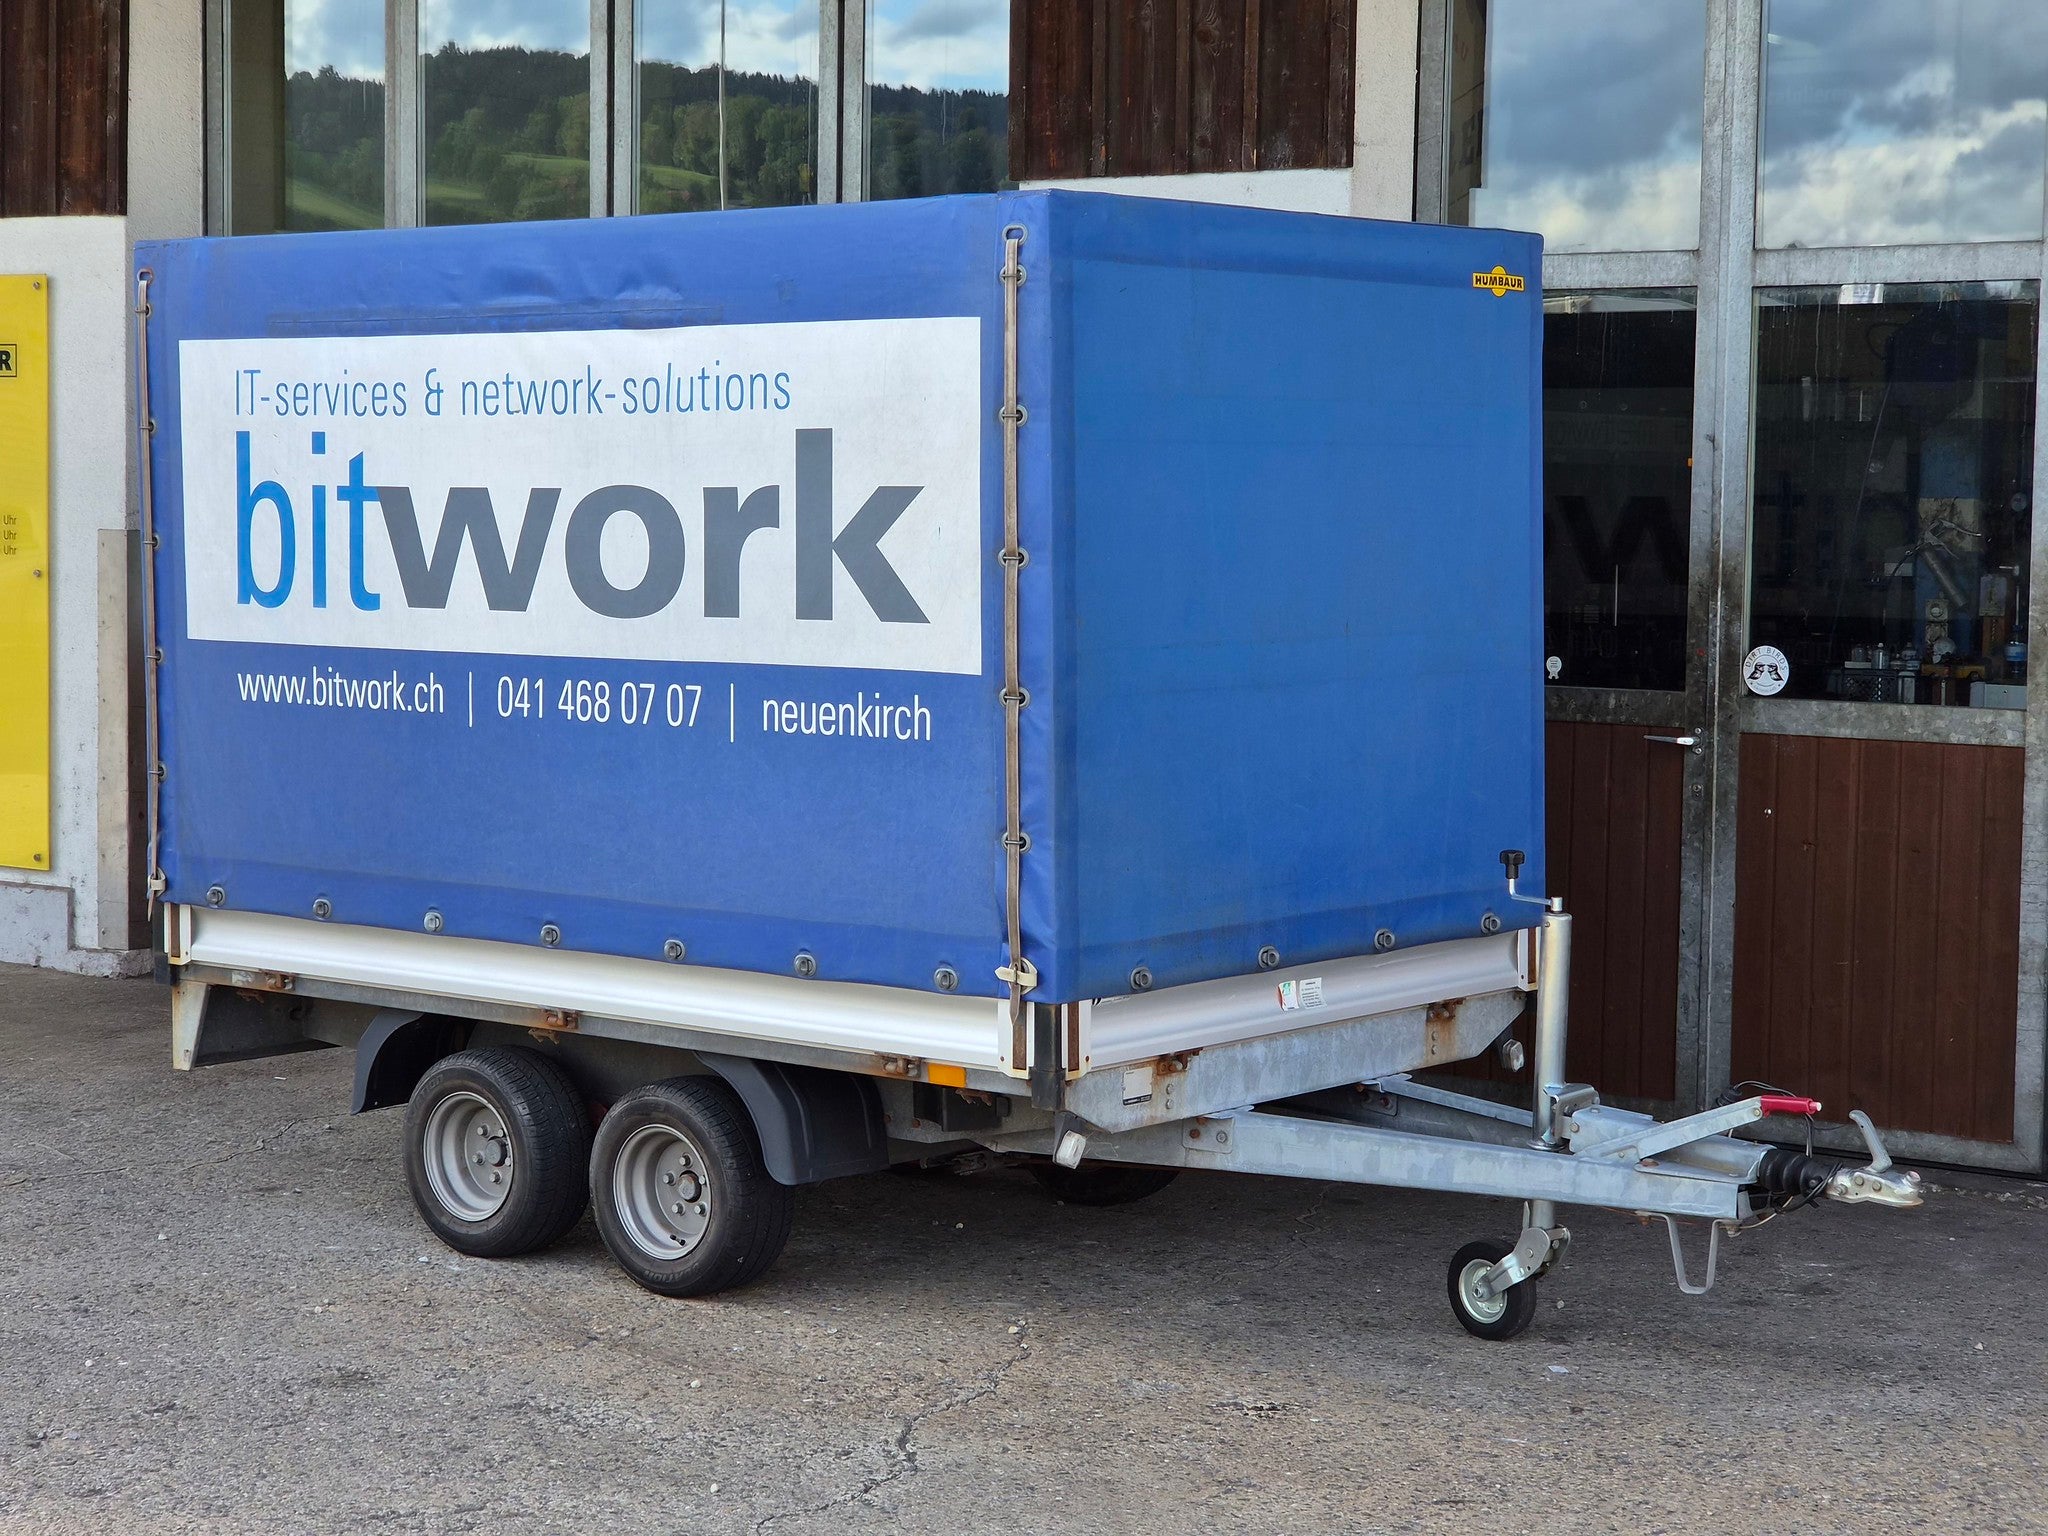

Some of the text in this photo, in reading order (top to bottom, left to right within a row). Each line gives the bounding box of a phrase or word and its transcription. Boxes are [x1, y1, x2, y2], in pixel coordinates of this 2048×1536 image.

[1475, 274, 1523, 289] HUMBAUR
[236, 360, 792, 417] IT-services & network-solutions
[3, 514, 17, 525] Uhr
[236, 428, 931, 624] bitwork
[3, 529, 17, 540] Uhr
[3, 545, 17, 555] Uhr
[1745, 647, 1788, 671] DIRT BIRDS
[237, 665, 444, 713] www.bitwork.ch
[497, 675, 543, 719] 041
[557, 679, 611, 723] 468
[620, 681, 656, 725] 07
[666, 683, 702, 727] 07
[763, 691, 931, 741] neuenkirch
